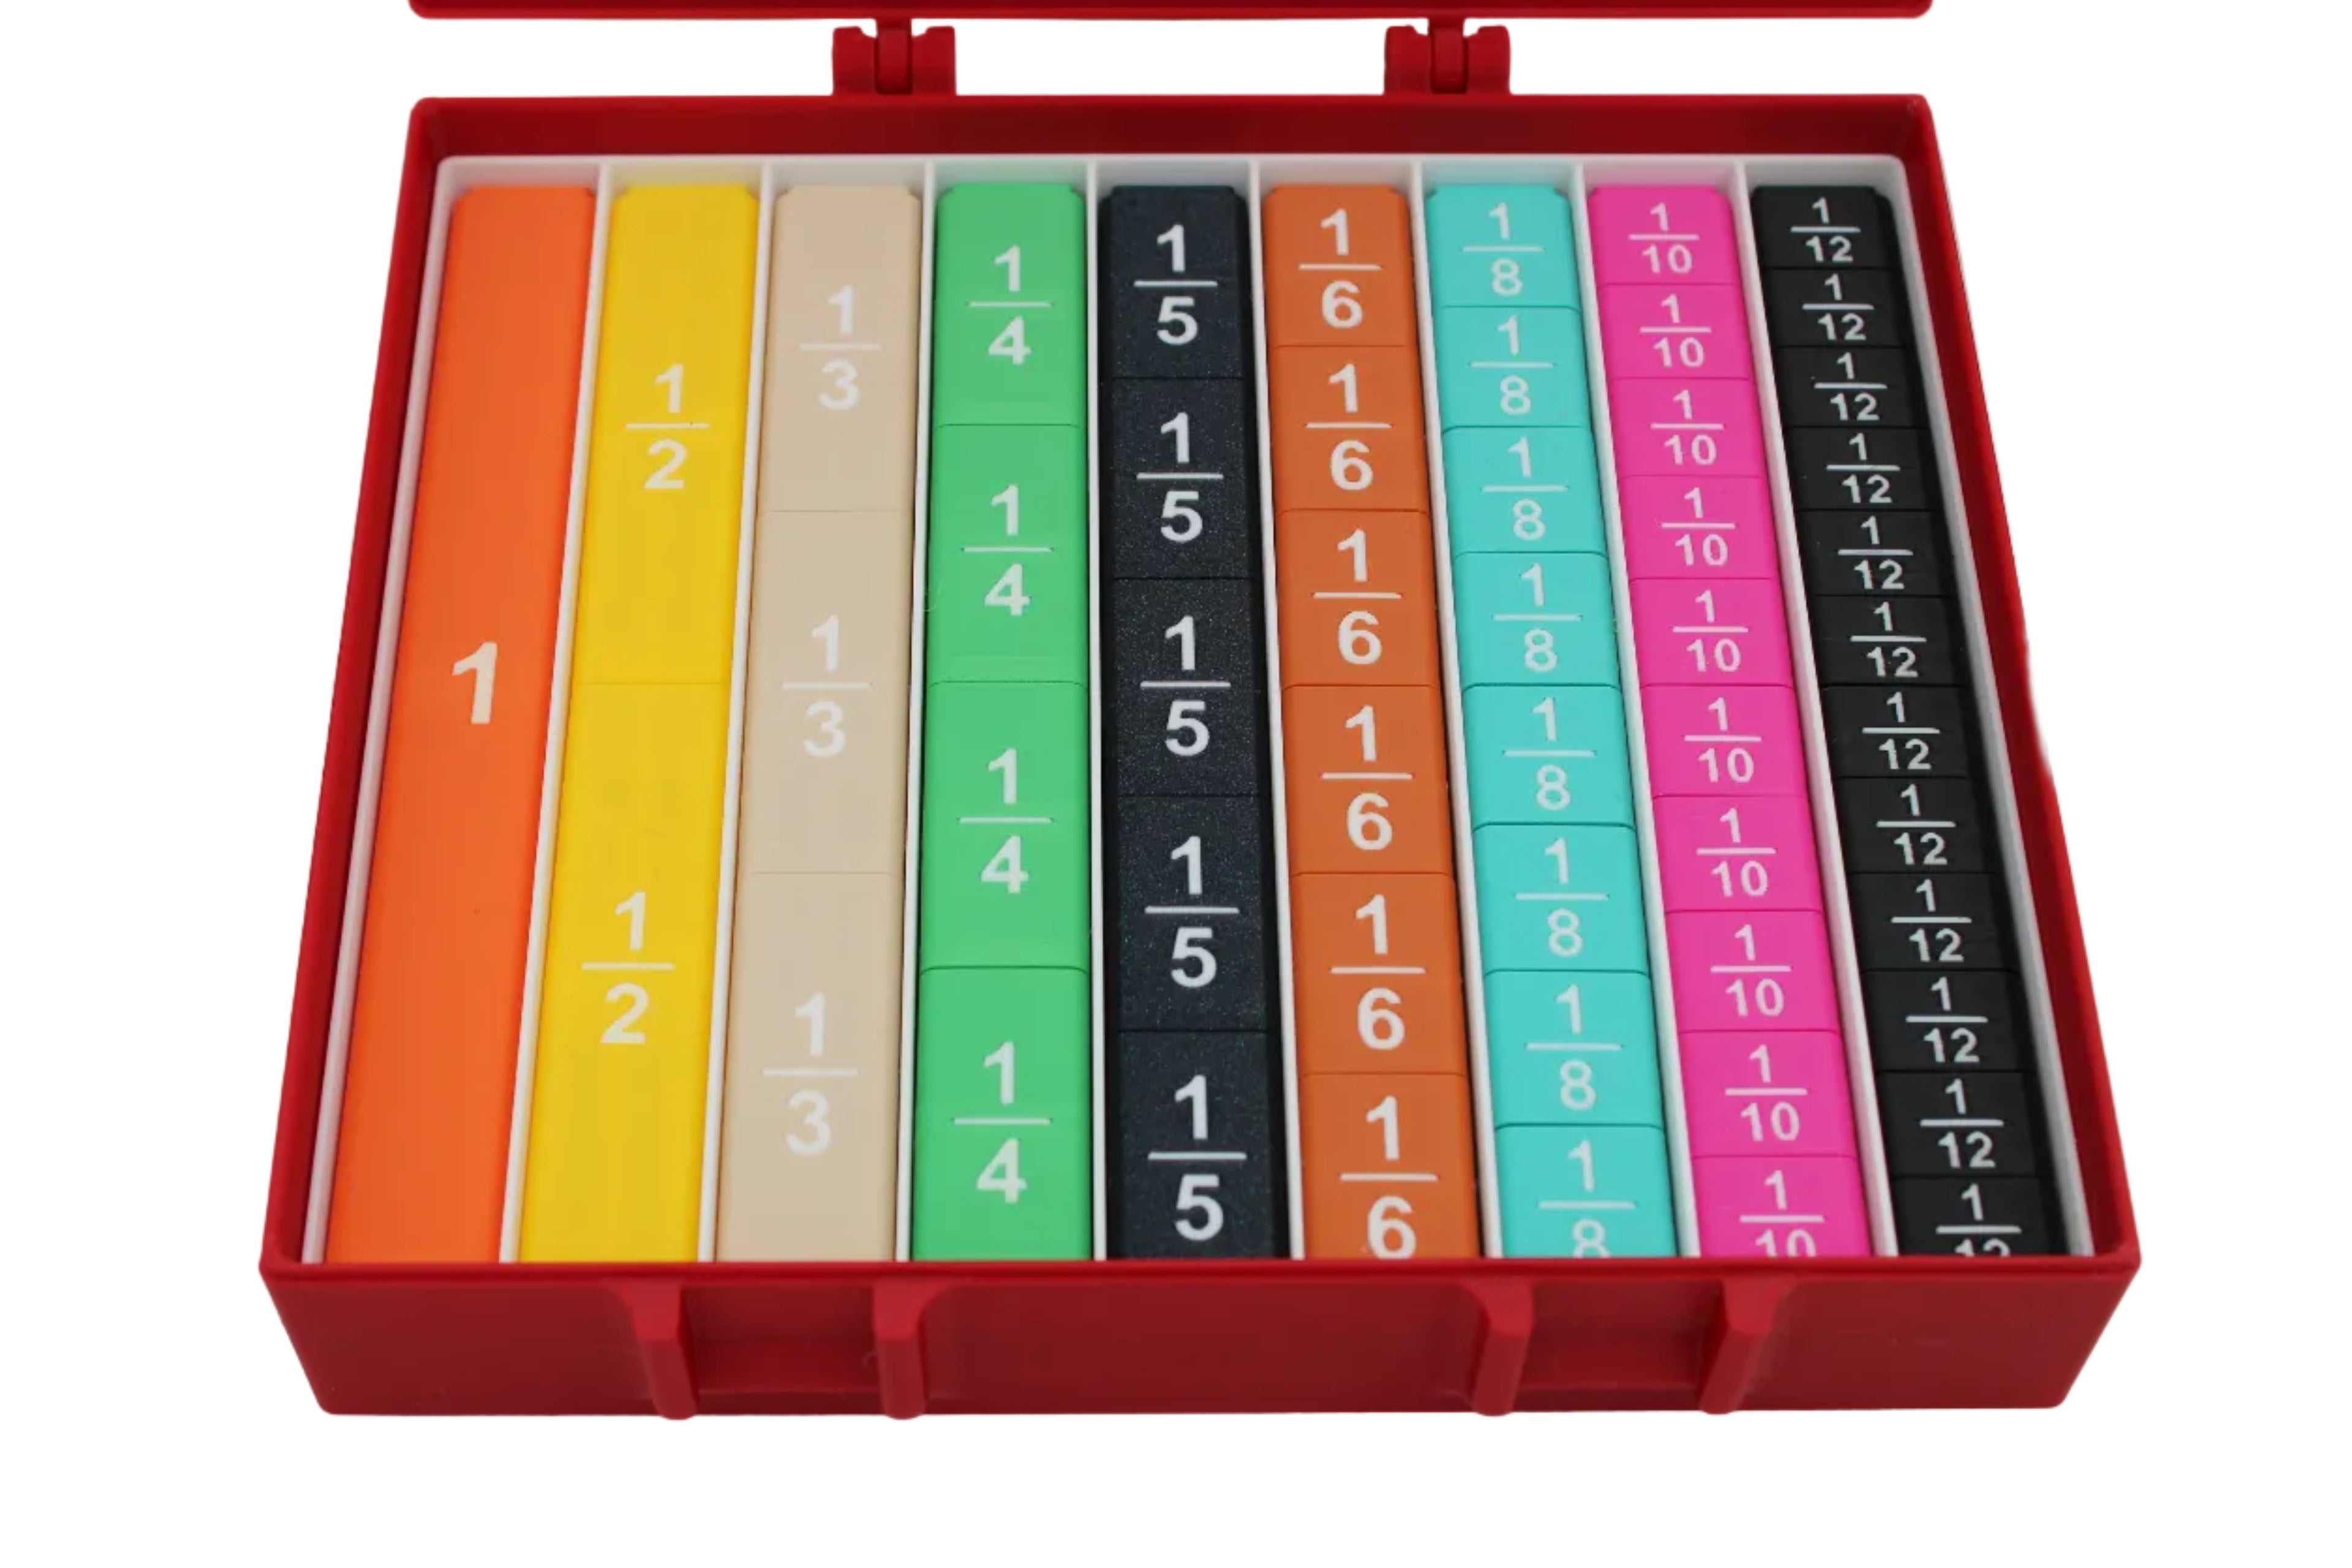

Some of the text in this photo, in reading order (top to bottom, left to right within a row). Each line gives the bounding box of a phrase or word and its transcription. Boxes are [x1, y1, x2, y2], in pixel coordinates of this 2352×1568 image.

[1490, 203, 1509, 238] 1
[1651, 203, 1668, 231] 1
[1813, 198, 1829, 223] 1
[1158, 225, 1184, 271] 1
[1322, 210, 1348, 255] 1
[1806, 236, 1853, 261] 12
[995, 246, 1020, 292] 1
[1491, 258, 1523, 295] 8
[1643, 244, 1692, 273] 10
[1322, 281, 1362, 327] 6
[1825, 274, 1841, 300] 1
[830, 286, 853, 333] 1
[1158, 296, 1197, 344] 5
[1662, 295, 1679, 323] 1
[1819, 313, 1866, 339] 12
[989, 317, 1030, 364] 4
[1498, 316, 1519, 354] 1
[1654, 337, 1703, 366] 10
[820, 359, 858, 409] 3
[1838, 353, 1853, 379] 1
[657, 364, 683, 413] 1
[1330, 364, 1357, 412] 1
[1501, 375, 1531, 414] 8
[1675, 390, 1692, 419] 1
[1831, 393, 1879, 420] 12
[1161, 413, 1189, 462] 1
[1510, 438, 1531, 477] 1
[1665, 435, 1716, 464] 10
[1850, 433, 1866, 460] 1
[645, 439, 687, 489] 2
[1331, 440, 1372, 490] 6
[992, 484, 1018, 535] 1
[1685, 488, 1703, 518] 1
[1842, 475, 1891, 503] 12
[1161, 491, 1202, 542] 5
[1513, 499, 1545, 540] 8
[1862, 516, 1879, 544] 1
[1338, 529, 1366, 581] 1
[1676, 534, 1727, 565] 10
[986, 564, 1029, 615] 4
[1522, 564, 1544, 605] 1
[1855, 560, 1904, 589] 12
[1696, 590, 1714, 622] 1
[1874, 602, 1892, 630] 1
[813, 616, 839, 671] 1
[1166, 616, 1194, 670] 1
[1338, 611, 1381, 664] 6
[1525, 628, 1557, 671] 8
[1687, 639, 1740, 671] 10
[453, 641, 497, 724] 1
[1868, 647, 1917, 677] 12
[1534, 698, 1556, 741] 1
[1709, 698, 1727, 730] 1
[1887, 692, 1904, 722] 1
[804, 701, 844, 755] 3
[1166, 701, 1209, 756] 5
[1346, 706, 1376, 761] 1
[1699, 748, 1754, 782] 10
[1880, 739, 1931, 769] 12
[989, 748, 1016, 804] 1
[1537, 765, 1570, 810] 8
[1901, 784, 1920, 816] 1
[1348, 792, 1392, 850] 6
[1721, 809, 1740, 842] 1
[982, 835, 1028, 892] 4
[1172, 837, 1202, 894] 1
[1546, 839, 1568, 883] 1
[1894, 832, 1947, 864] 12
[1713, 861, 1767, 896] 10
[1917, 880, 1936, 911] 1
[616, 892, 646, 950] 1
[1357, 895, 1387, 954] 1
[1548, 908, 1583, 957] 8
[1172, 927, 1216, 987] 5
[1735, 925, 1755, 960] 1
[1910, 929, 1963, 962] 12
[601, 982, 649, 1043] 2
[1558, 985, 1581, 1033] 1
[1727, 979, 1783, 1016] 10
[1932, 977, 1950, 1011] 1
[796, 993, 824, 1056] 1
[1359, 988, 1404, 1049] 6
[1751, 1046, 1770, 1082] 1
[1924, 1028, 1978, 1062] 12
[985, 1042, 1014, 1104] 1
[1560, 1060, 1596, 1110] 8
[1175, 1076, 1207, 1139] 1
[1946, 1079, 1966, 1114] 1
[787, 1091, 830, 1154] 3
[1366, 1096, 1399, 1159] 1
[1741, 1102, 1799, 1140] 10
[1569, 1140, 1594, 1190] 1
[1939, 1132, 1994, 1167] 12
[977, 1139, 1026, 1202] 4
[1765, 1170, 1786, 1208] 1
[1177, 1175, 1223, 1240] 5
[1962, 1184, 1983, 1220] 1
[1368, 1197, 1415, 1258] 6
[1573, 1219, 1611, 1257] 8
[1757, 1230, 1815, 1257] 10
